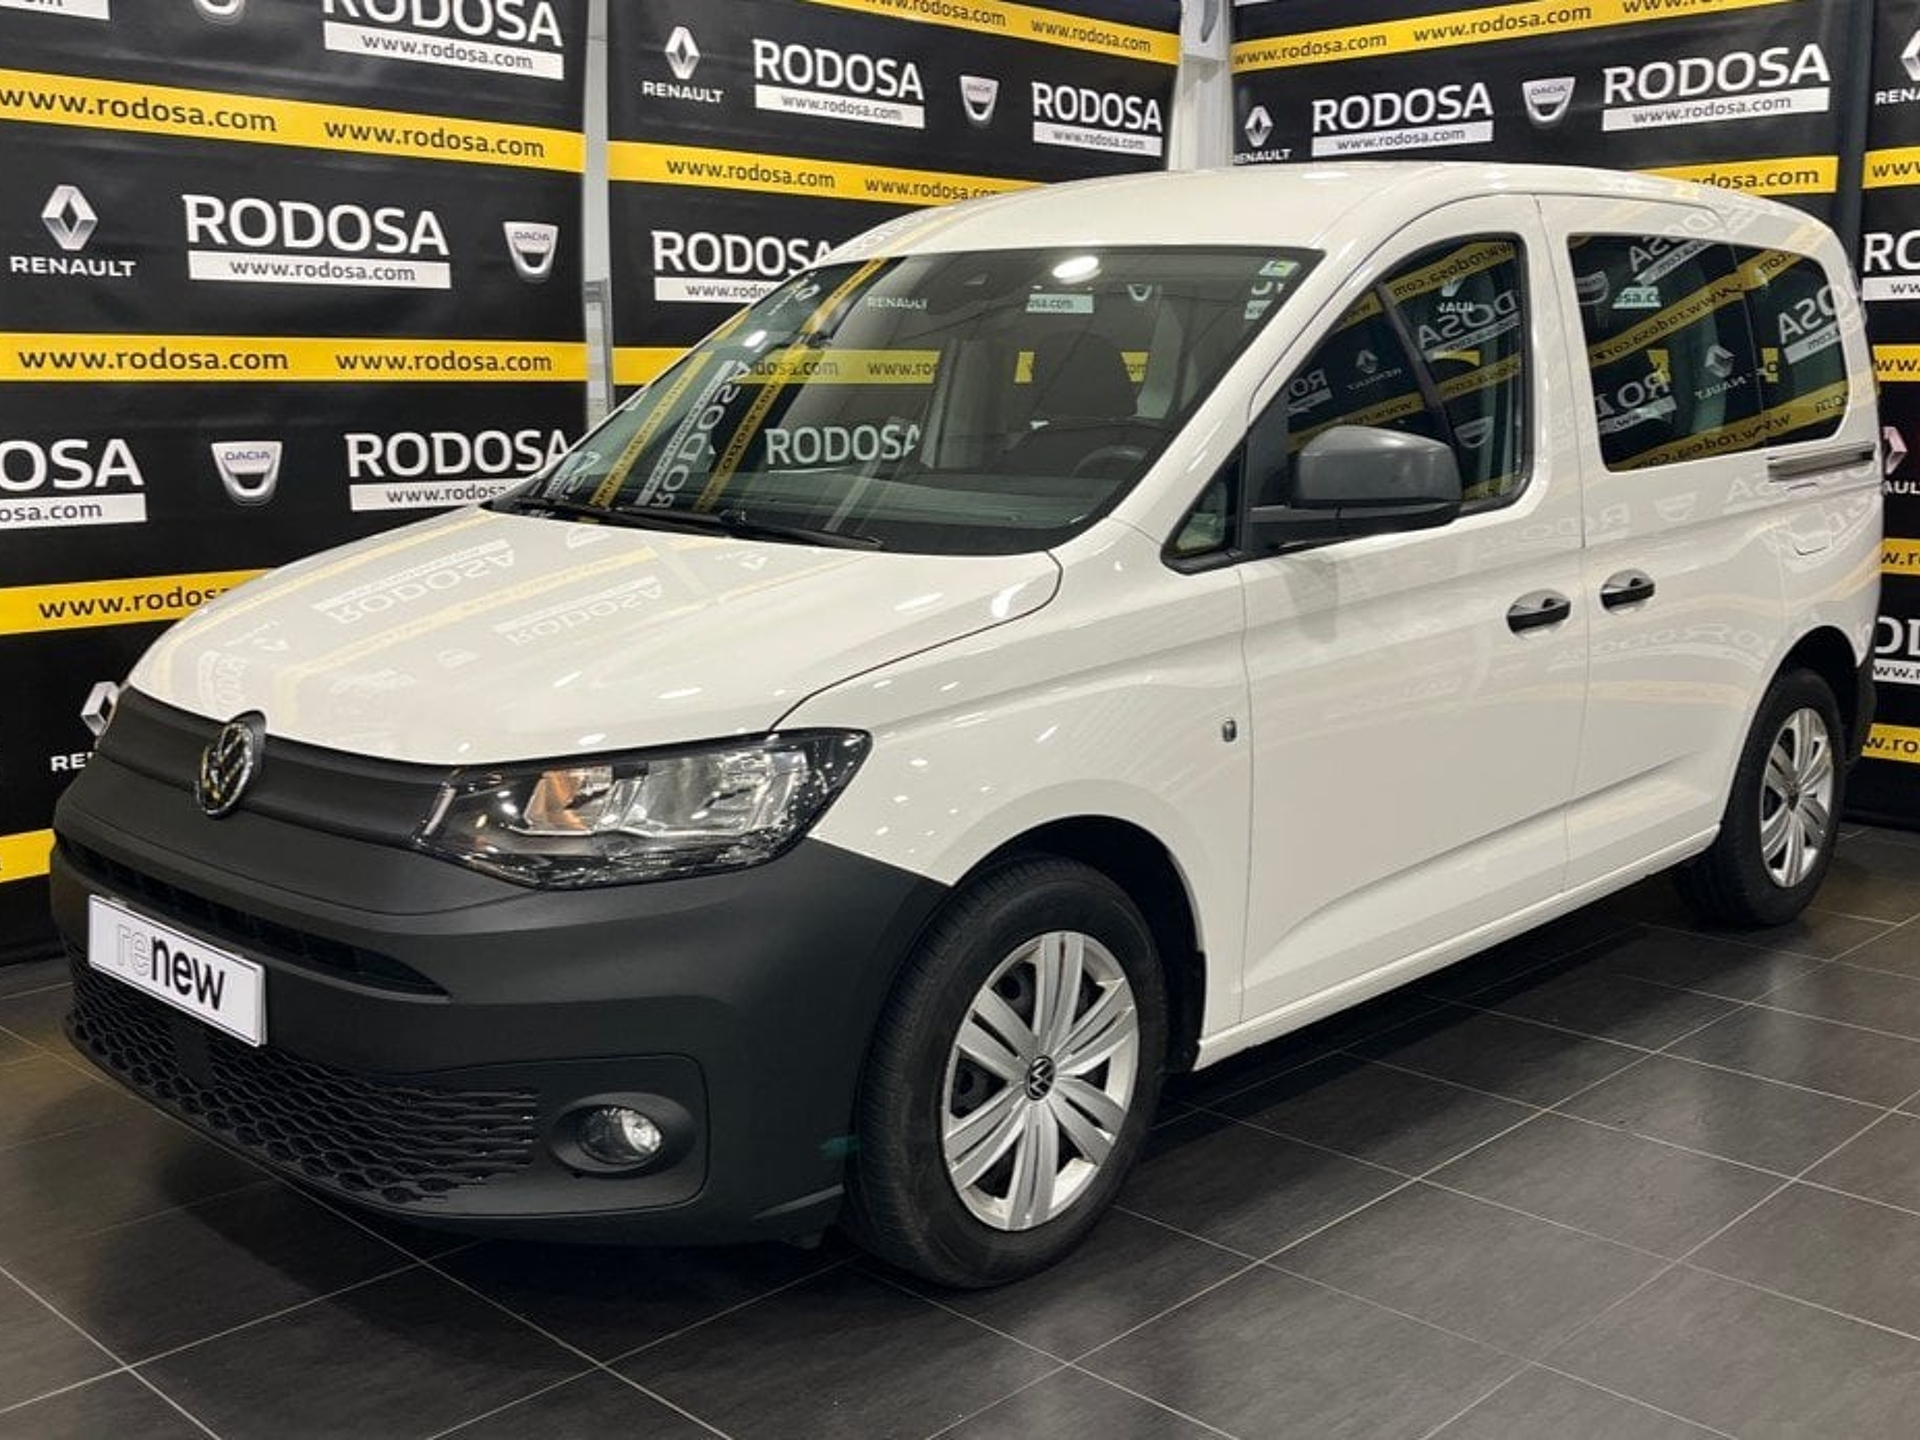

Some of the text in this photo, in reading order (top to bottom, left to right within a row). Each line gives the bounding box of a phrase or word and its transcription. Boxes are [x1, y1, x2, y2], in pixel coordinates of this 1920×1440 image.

[323, 0, 563, 47] DOSA
[865, 0, 1006, 26] w.rodosa.com
[1413, 5, 1591, 42] www.rodosa.com
[1031, 17, 1151, 52] www.rodosa.com
[1234, 33, 1387, 65] www.rodosa.com
[361, 34, 533, 69] www.rodosa.com
[752, 38, 924, 101] RODOSA
[1602, 43, 1830, 104] RODOSA
[642, 80, 724, 103] RENAULT
[781, 94, 902, 121] www.rodosa.com
[1031, 82, 1163, 133] RODOSA
[1311, 82, 1493, 133] RODOSA
[0, 89, 277, 132] www.rodosa.com
[1632, 96, 1791, 124] www.rodosa.com
[324, 121, 545, 158] www.rodosa.com
[1052, 130, 1146, 150] www.rodosa.com
[1337, 128, 1465, 151] www.rodosa.com
[666, 158, 836, 189] www.rodosa.com
[182, 194, 450, 256] RODOSA
[10, 255, 137, 277] RENAULT
[229, 260, 416, 282] www.rodosa.com
[18, 347, 289, 370] www.rodosa.com
[336, 350, 552, 372] www.rodosa.com
[224, 450, 271, 462] DACIA
[344, 429, 569, 478] RODOSA
[765, 424, 920, 465] RODOSA
[39, 586, 230, 618] www.rodos
[115, 923, 225, 1010] renew
